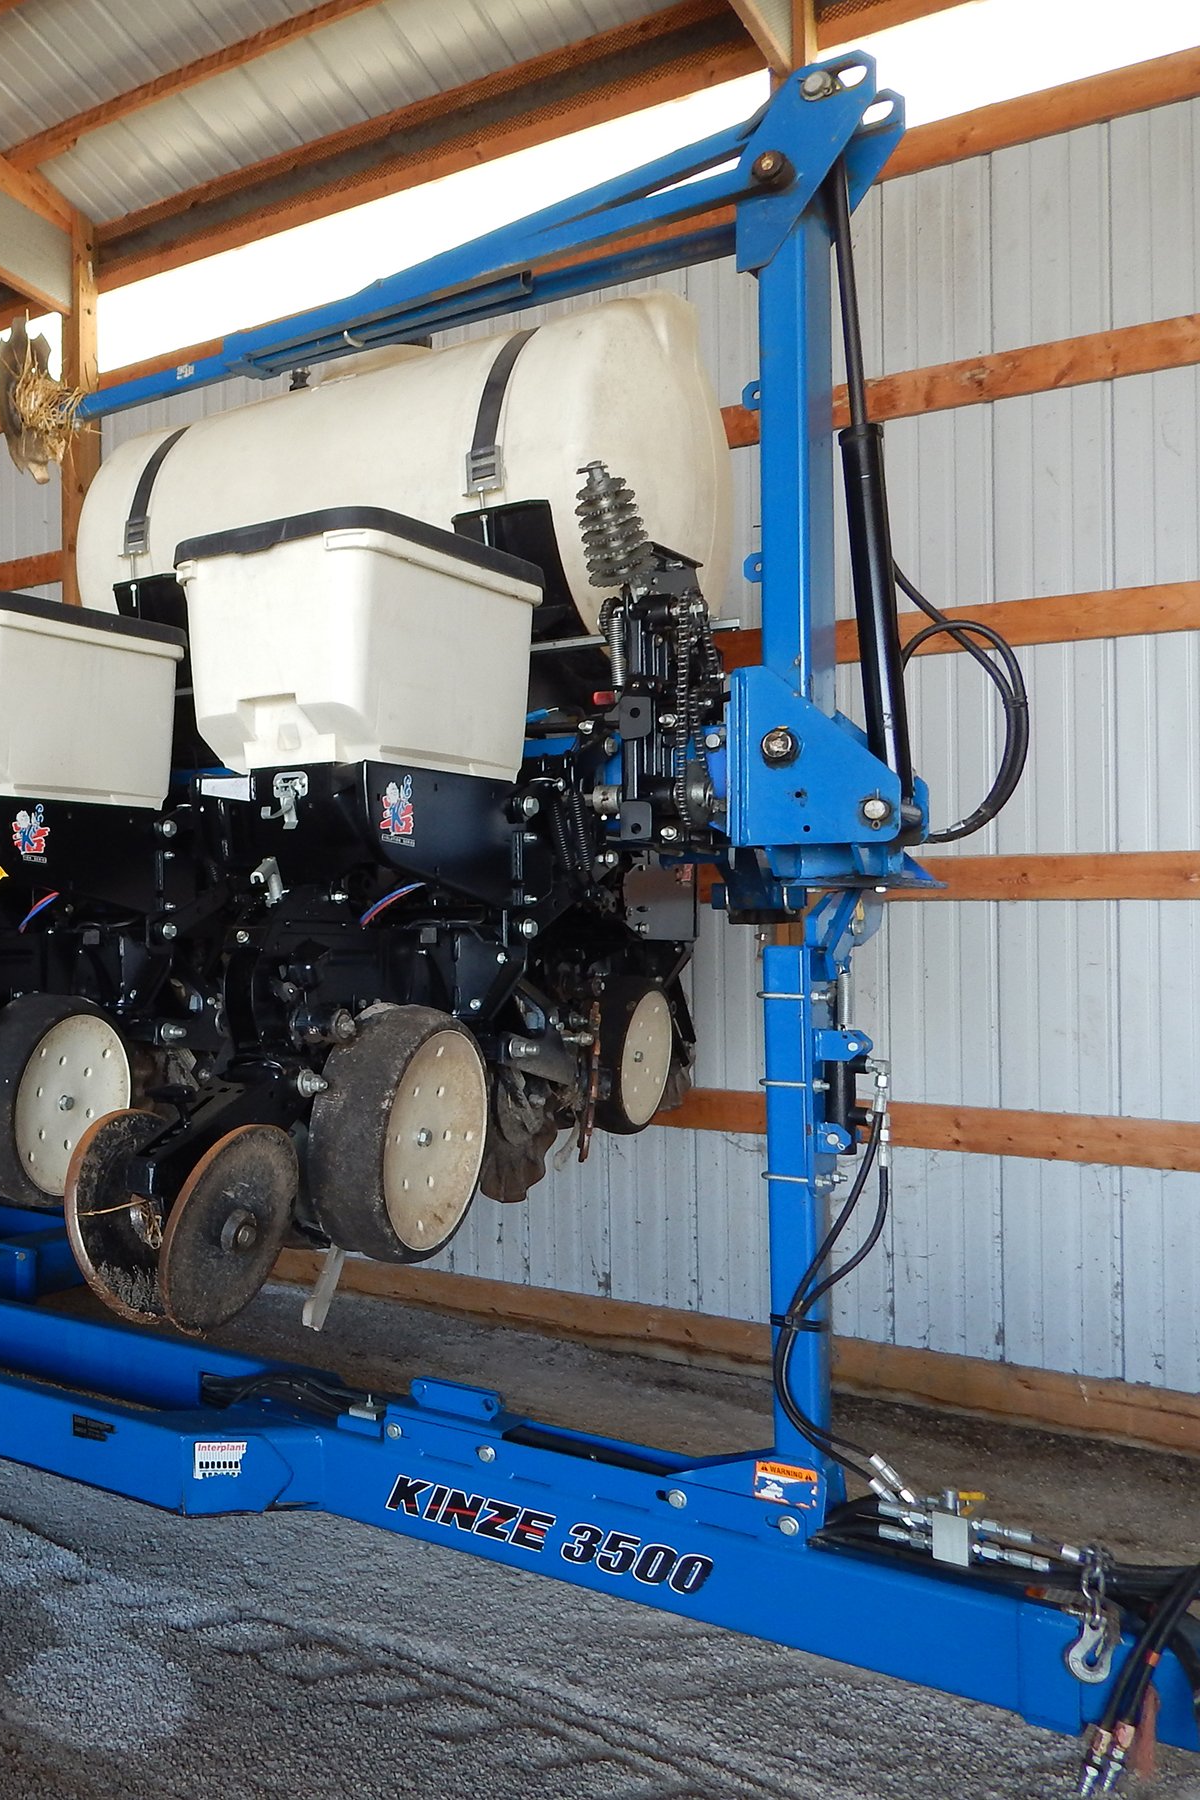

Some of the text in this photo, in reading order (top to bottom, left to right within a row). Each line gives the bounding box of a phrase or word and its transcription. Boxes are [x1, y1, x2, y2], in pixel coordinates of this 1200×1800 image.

[197, 1443, 245, 1453] Interplant
[769, 1465, 804, 1480] WARNING
[385, 1474, 715, 1595] KINZE 3500
